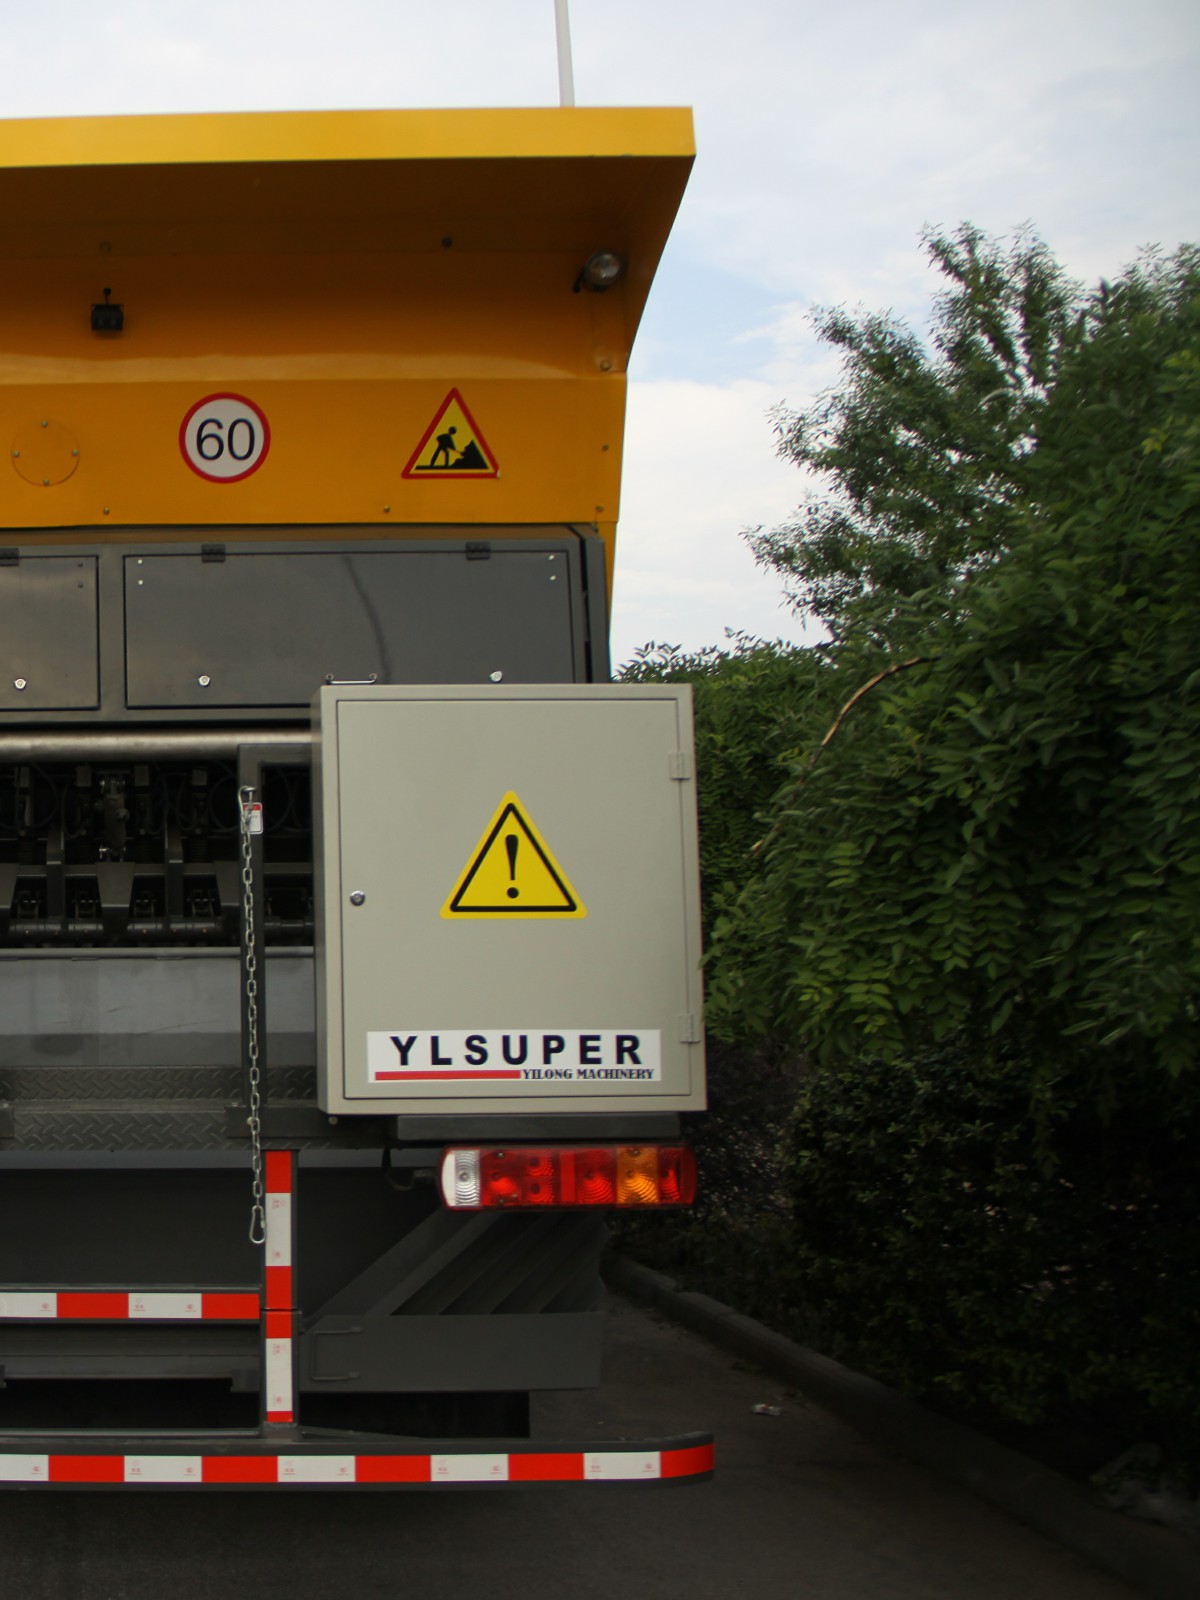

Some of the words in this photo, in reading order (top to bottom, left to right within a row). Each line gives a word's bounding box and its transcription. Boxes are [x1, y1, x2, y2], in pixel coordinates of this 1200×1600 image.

[196, 418, 255, 462] 60
[390, 1034, 643, 1066] YLSUPER
[522, 1069, 573, 1080] YILONG
[576, 1068, 655, 1079] MACHINERY
